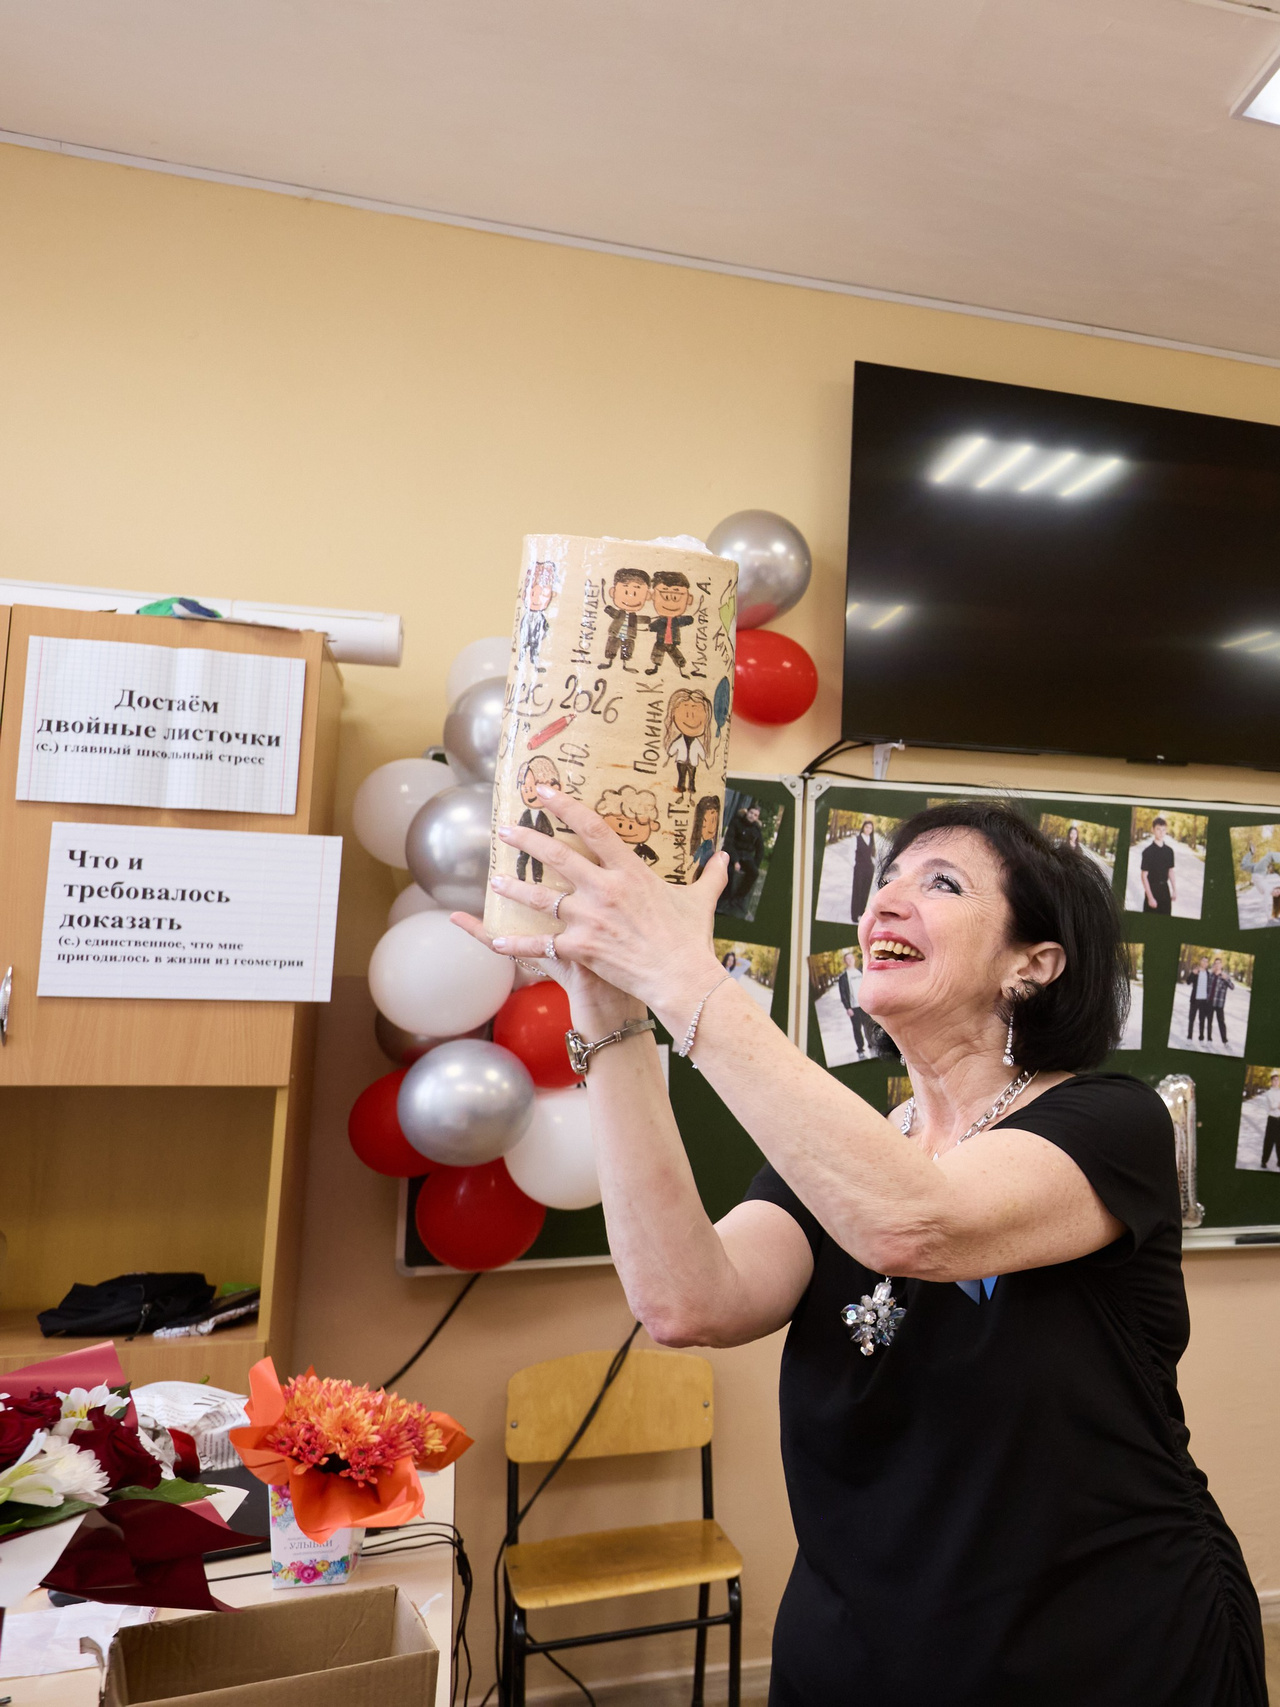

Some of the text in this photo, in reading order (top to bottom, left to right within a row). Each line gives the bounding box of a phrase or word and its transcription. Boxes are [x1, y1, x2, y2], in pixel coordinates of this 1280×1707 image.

[114, 689, 219, 713] Достаём
[560, 674, 623, 724] 2026
[37, 716, 281, 747] двойные листочки
[633, 700, 664, 775] ПОЛИНА
[36, 741, 265, 765] (с.) главный школьный стресс
[67, 849, 144, 871] Что и
[63, 881, 231, 904] требовалось
[59, 913, 183, 931] доказать
[58, 936, 244, 952] (с.) единственное, что мне
[57, 952, 150, 964] пригодилось
[166, 956, 210, 965] жизни
[215, 957, 229, 966] из
[234, 958, 304, 969] геометрии
